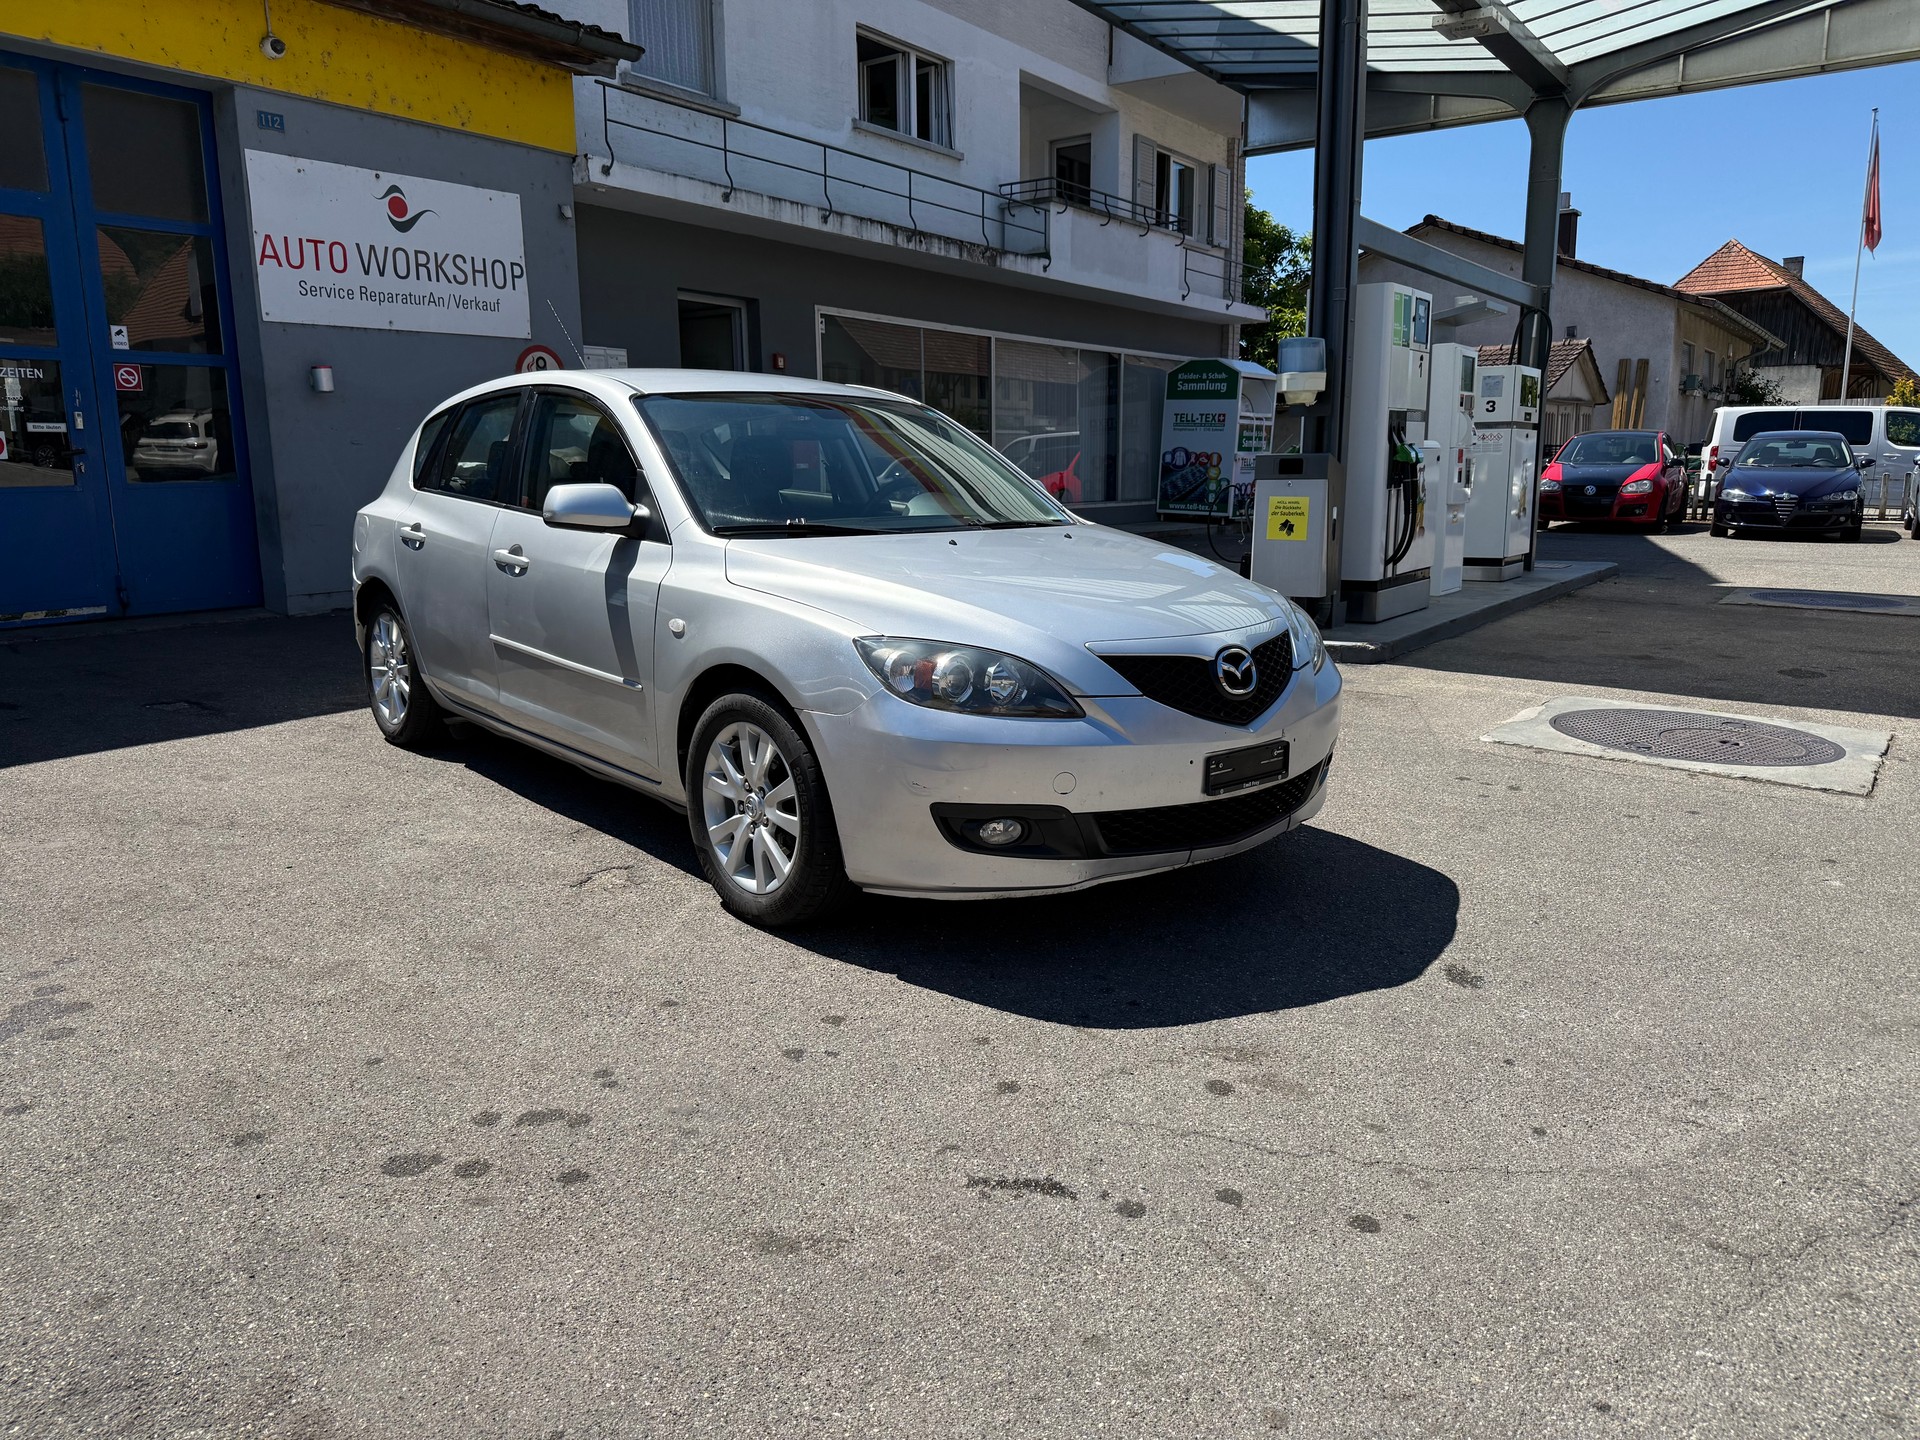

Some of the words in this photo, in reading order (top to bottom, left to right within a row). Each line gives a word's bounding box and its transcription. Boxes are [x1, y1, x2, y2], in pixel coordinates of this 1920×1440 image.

[260, 113, 281, 129] 112
[259, 234, 349, 274] AUTO
[355, 243, 524, 291] WORKSHOP
[299, 280, 355, 301] Service
[1178, 372, 1201, 380] Kleider-
[1202, 372, 1207, 380] &
[1208, 371, 1229, 380] Schuh-
[1177, 380, 1227, 392] Sammlung
[1485, 400, 1497, 413] 3
[1174, 413, 1217, 422] TELL-TEX
[1169, 503, 1218, 511] www.tell-tex.h
